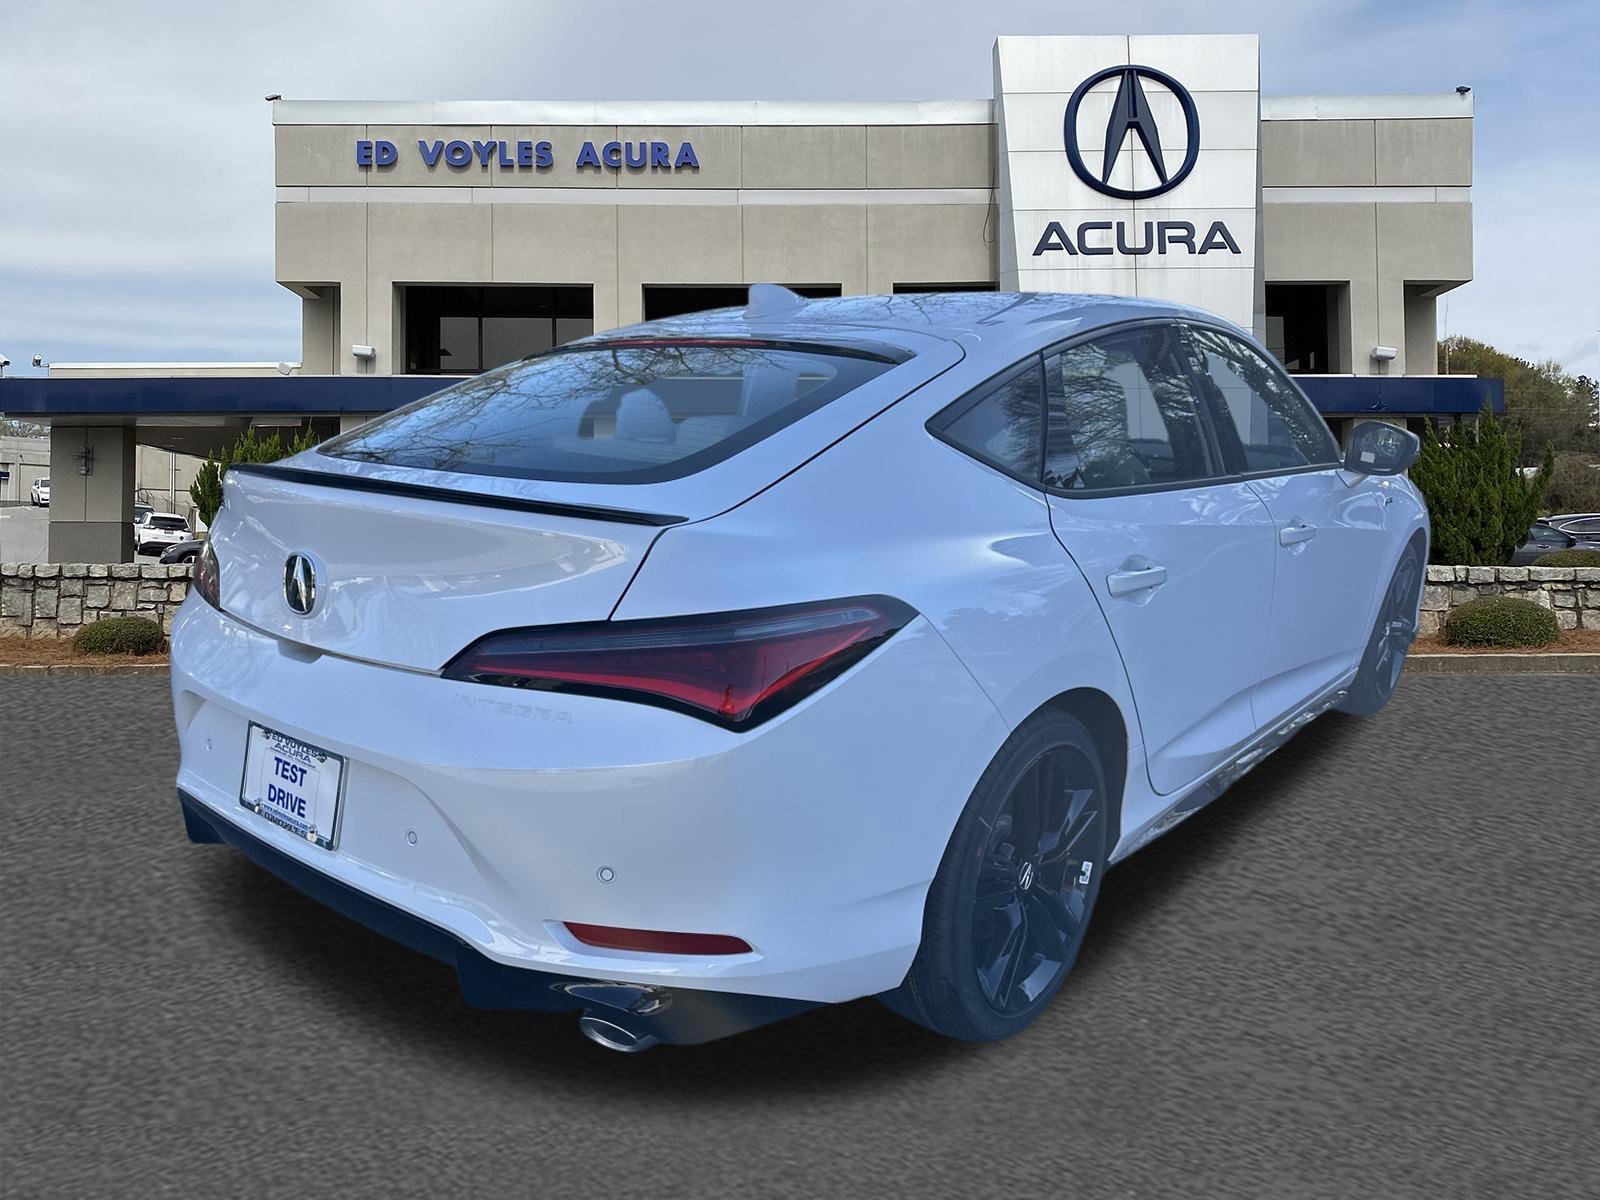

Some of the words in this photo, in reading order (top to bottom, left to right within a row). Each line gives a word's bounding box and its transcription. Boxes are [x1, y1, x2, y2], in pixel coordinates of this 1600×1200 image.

[356, 140, 398, 168] ED
[418, 140, 554, 168] VOYLES
[576, 141, 700, 169] ACURA
[1032, 221, 1242, 256] ACURA
[274, 742, 312, 764] ACURA
[274, 756, 308, 787] TEST
[267, 783, 307, 819] DRIVE
